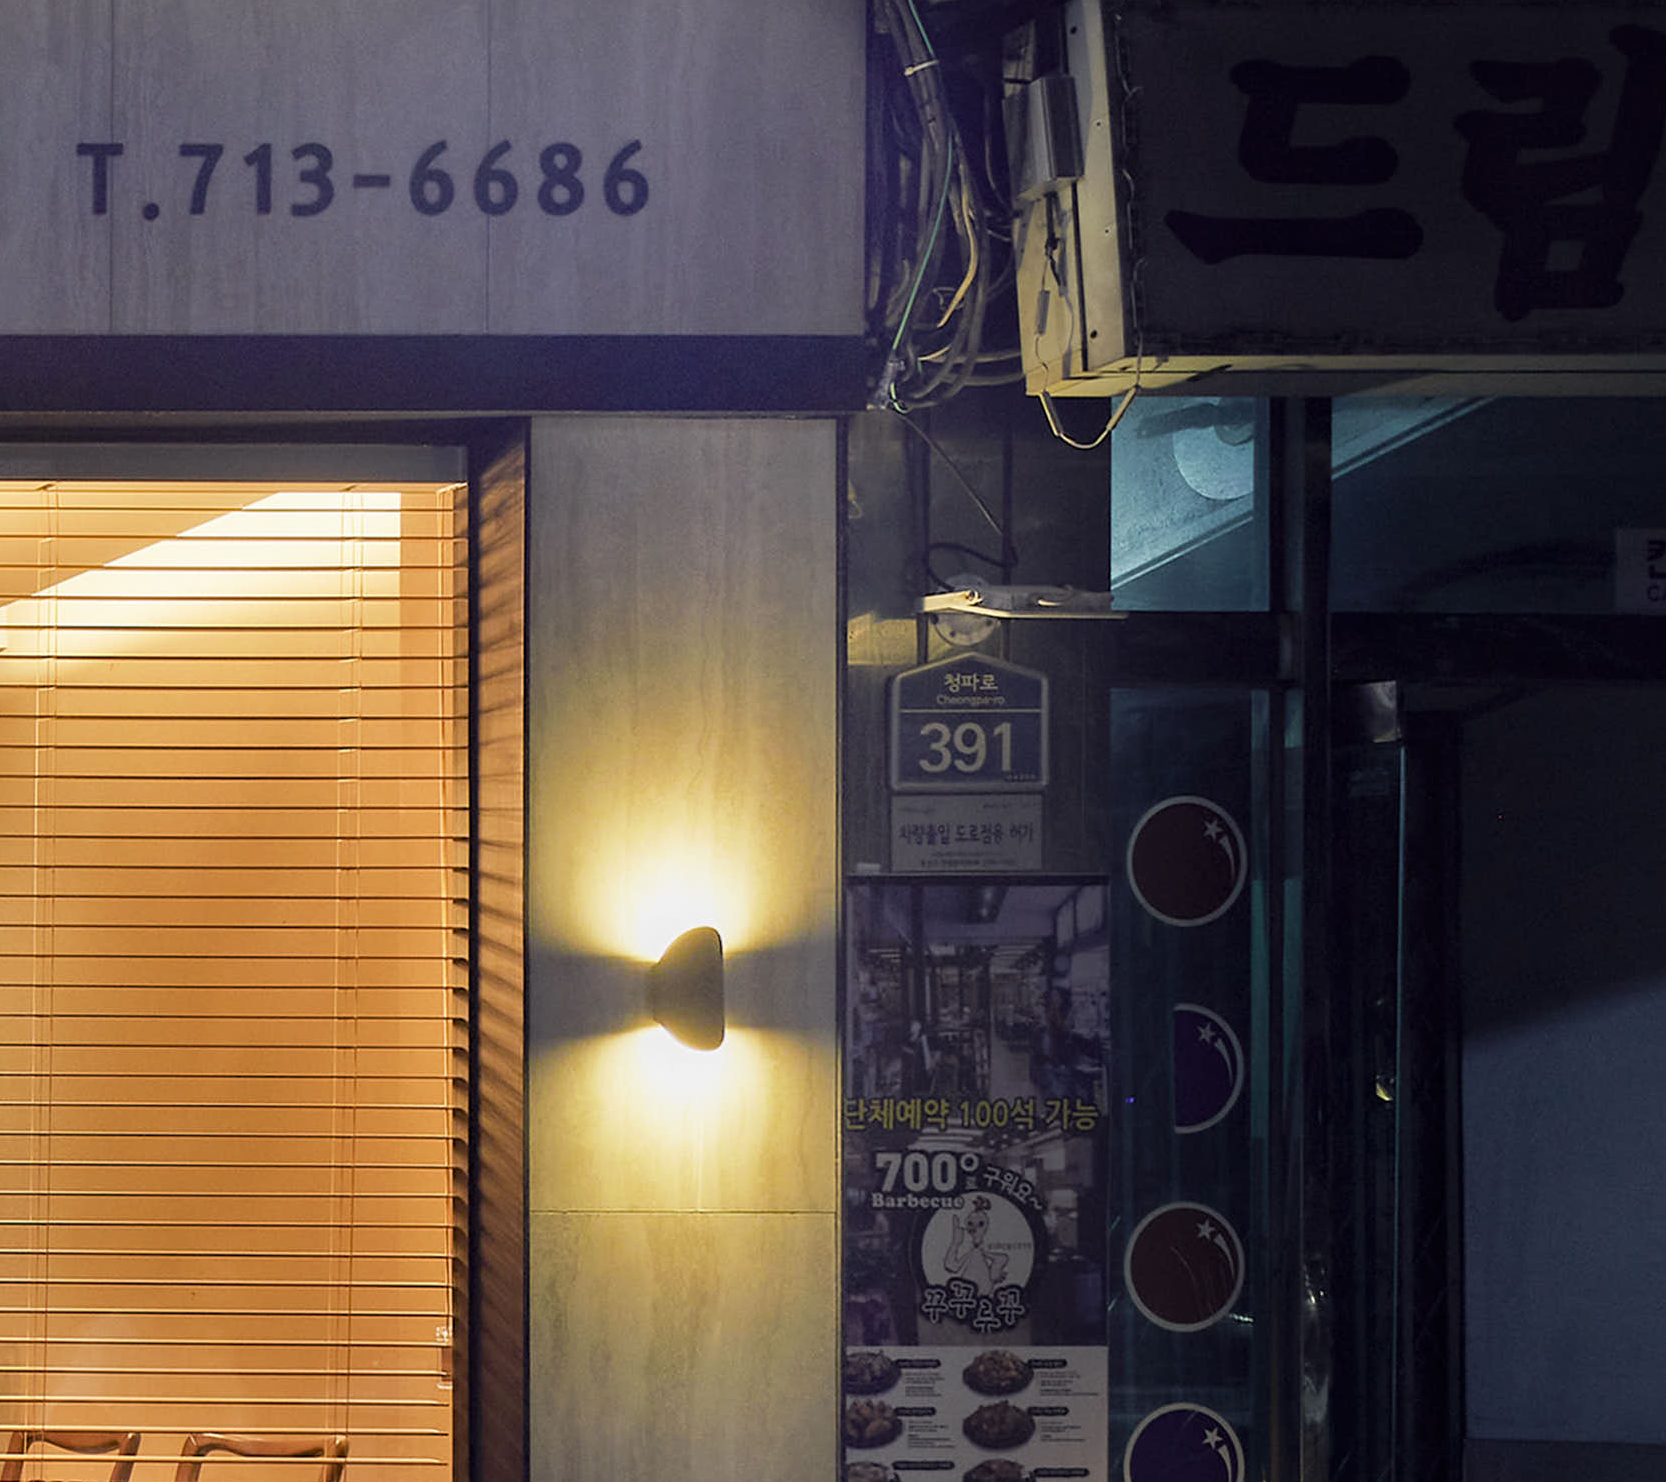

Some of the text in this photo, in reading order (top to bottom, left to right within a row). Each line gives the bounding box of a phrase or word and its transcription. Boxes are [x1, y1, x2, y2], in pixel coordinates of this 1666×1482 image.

[75, 138, 651, 221] T.713-6686
[944, 672, 999, 693] 청파로
[918, 721, 1014, 774] 391
[843, 1097, 1100, 1131] 단체예약 100석 가능
[870, 1193, 965, 1210] Barbecue
